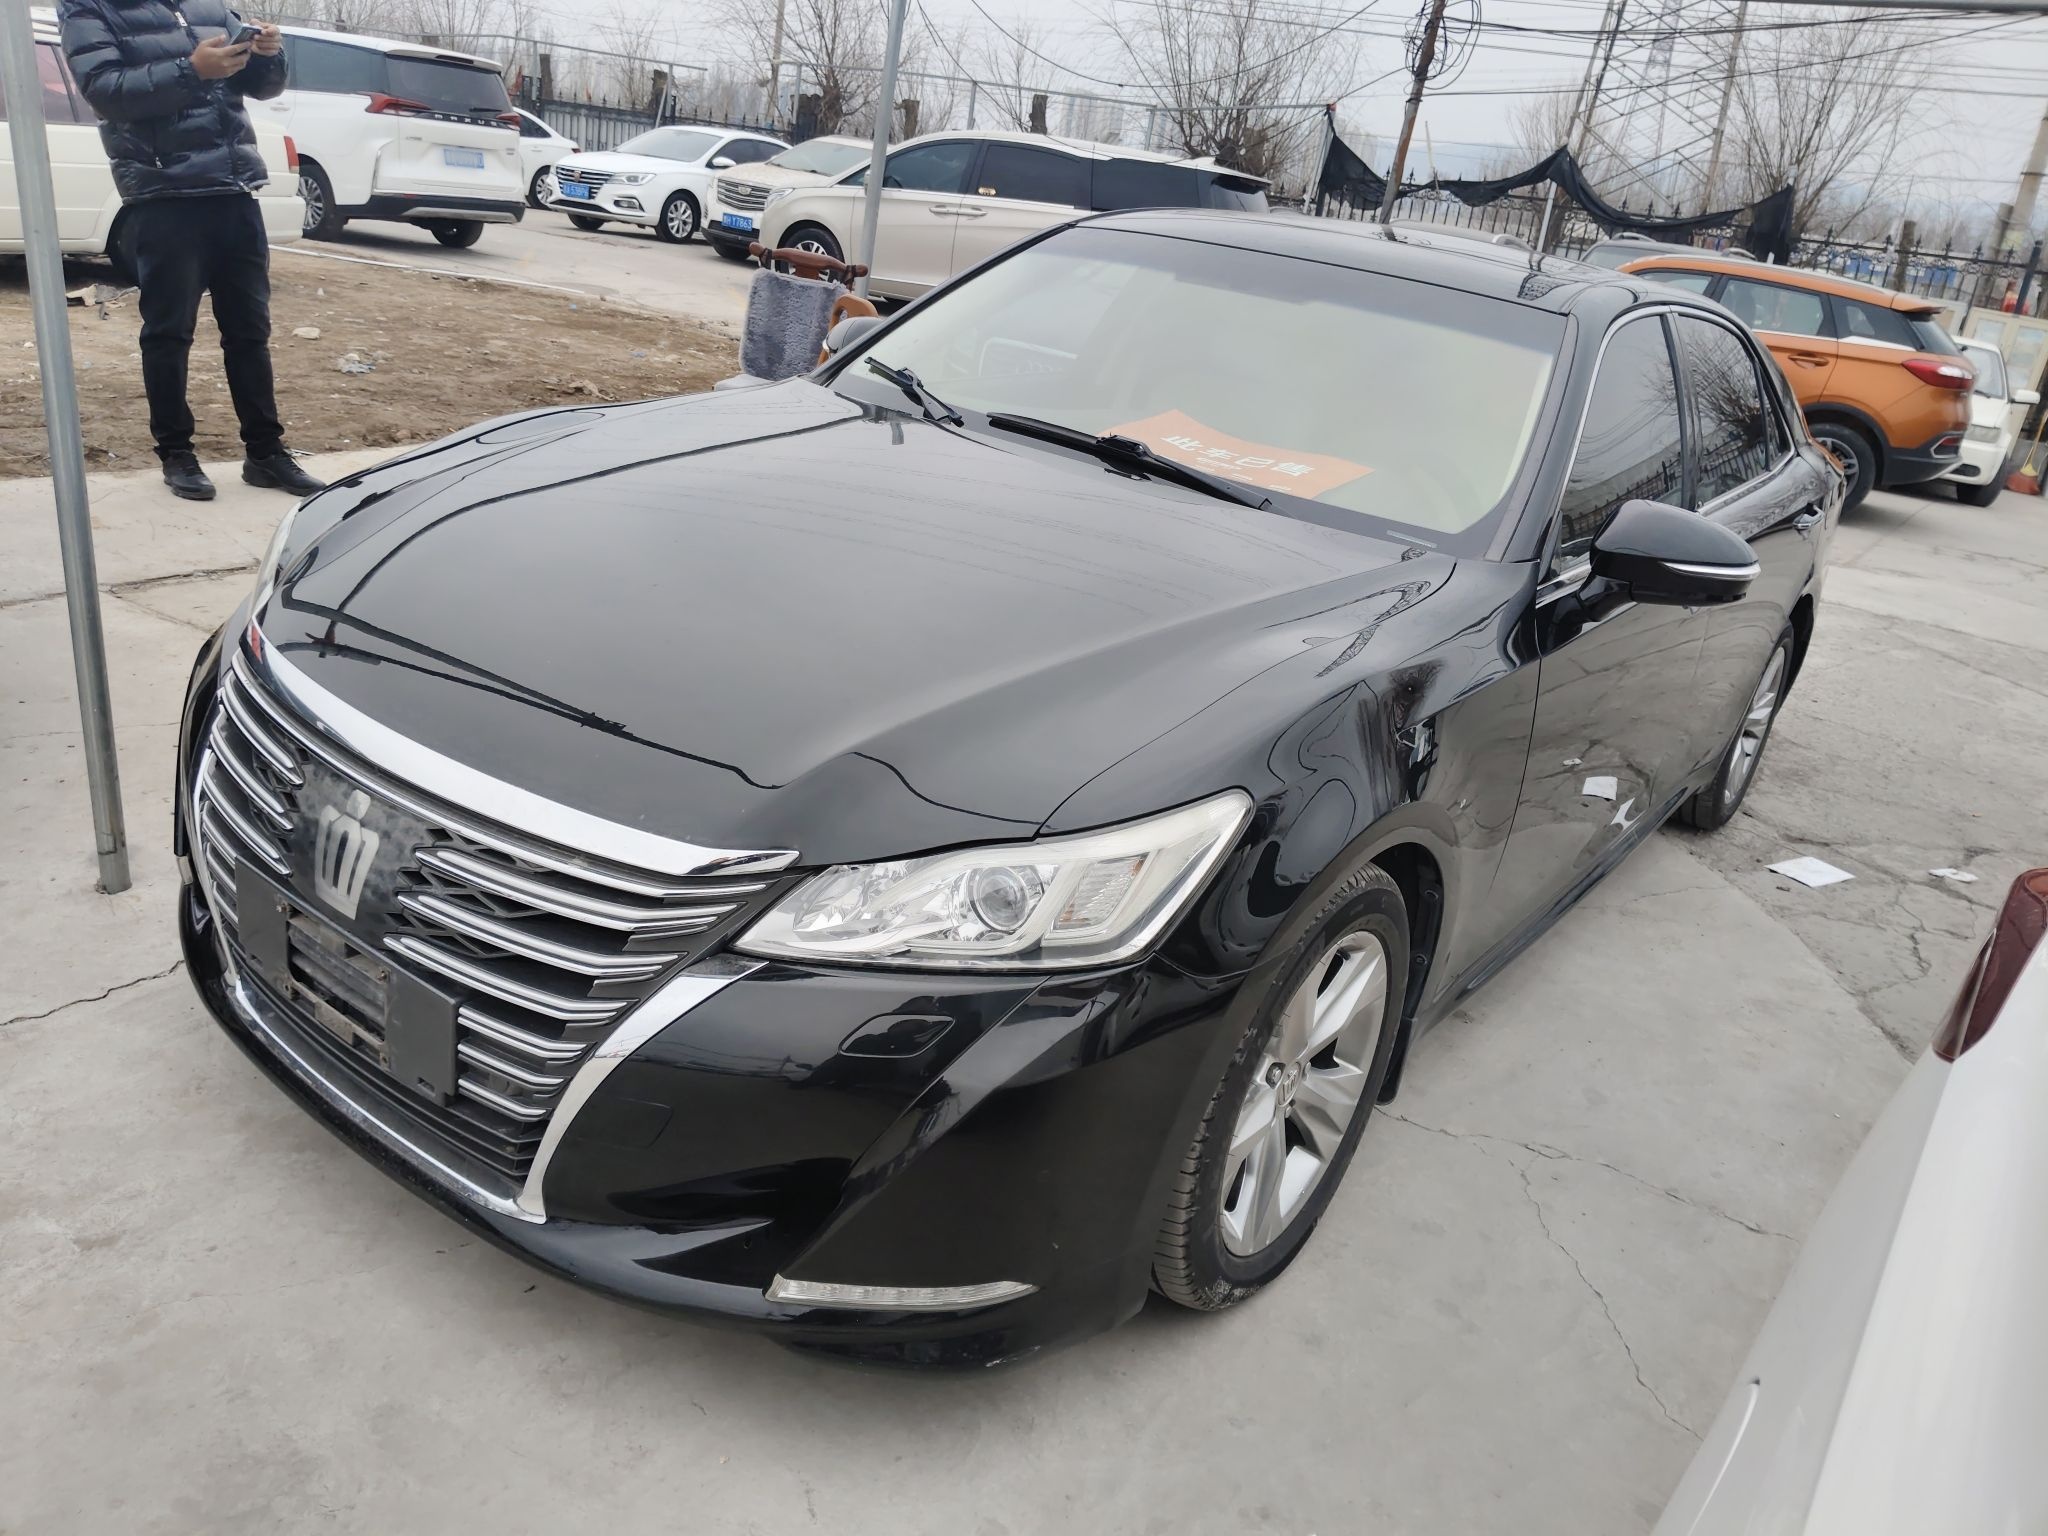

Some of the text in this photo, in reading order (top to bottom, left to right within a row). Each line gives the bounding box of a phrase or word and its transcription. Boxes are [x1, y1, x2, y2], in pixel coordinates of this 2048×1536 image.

[434, 113, 498, 127] MAXUS
[1160, 435, 1316, 477] 此车已售
